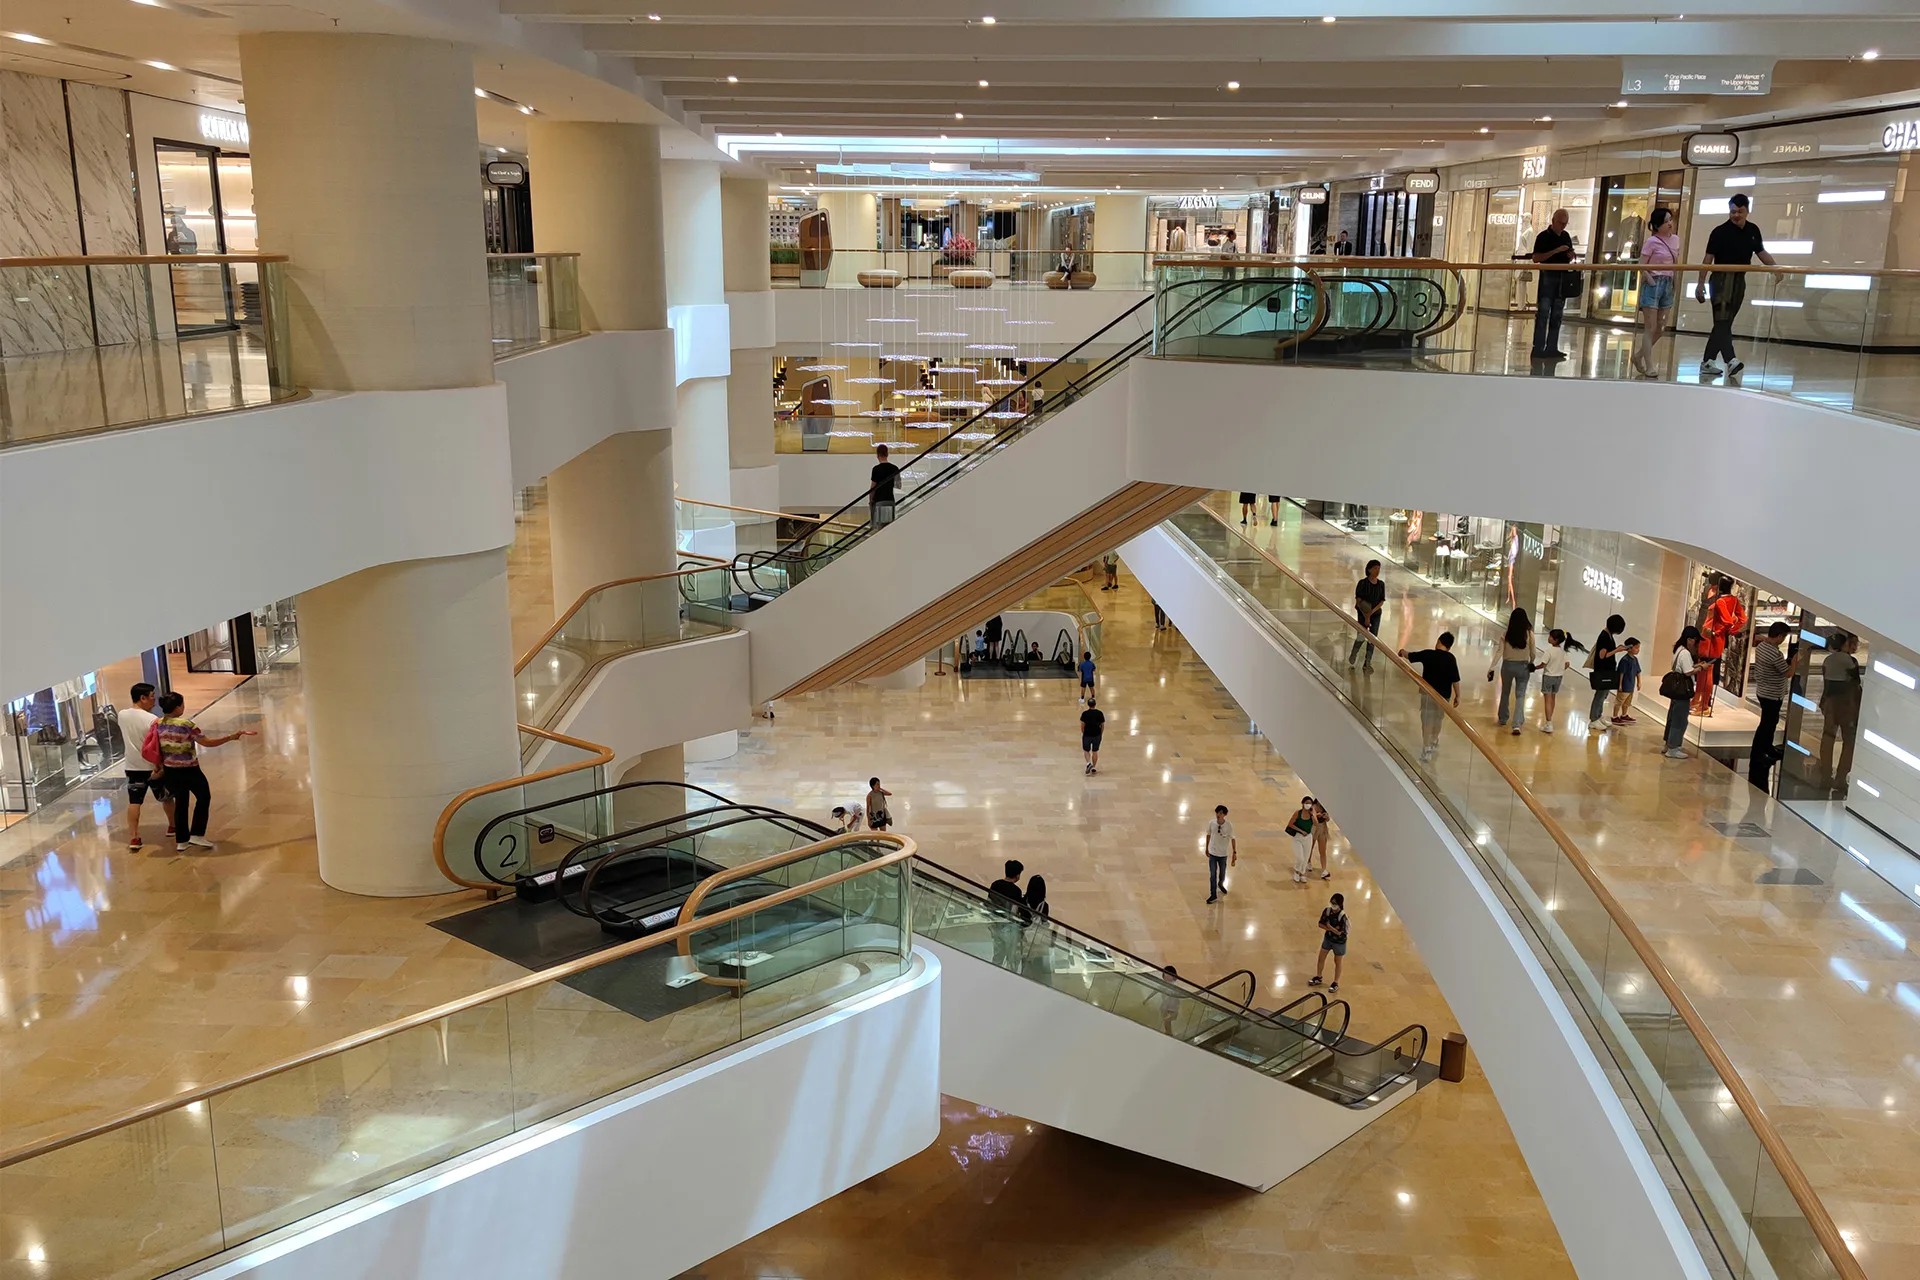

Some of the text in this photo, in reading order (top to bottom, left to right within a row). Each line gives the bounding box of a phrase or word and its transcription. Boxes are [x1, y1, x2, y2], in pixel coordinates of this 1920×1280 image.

[1627, 79, 1642, 91] L3
[1693, 145, 1731, 154] CHANEL
[1410, 179, 1434, 188] FENDI
[1300, 191, 1326, 200] CELINE
[1178, 195, 1217, 209] ZEGNA
[1488, 213, 1517, 225] FENDI
[1411, 292, 1428, 318] 3
[1581, 564, 1626, 602] CHANEL
[498, 834, 519, 868] 2
